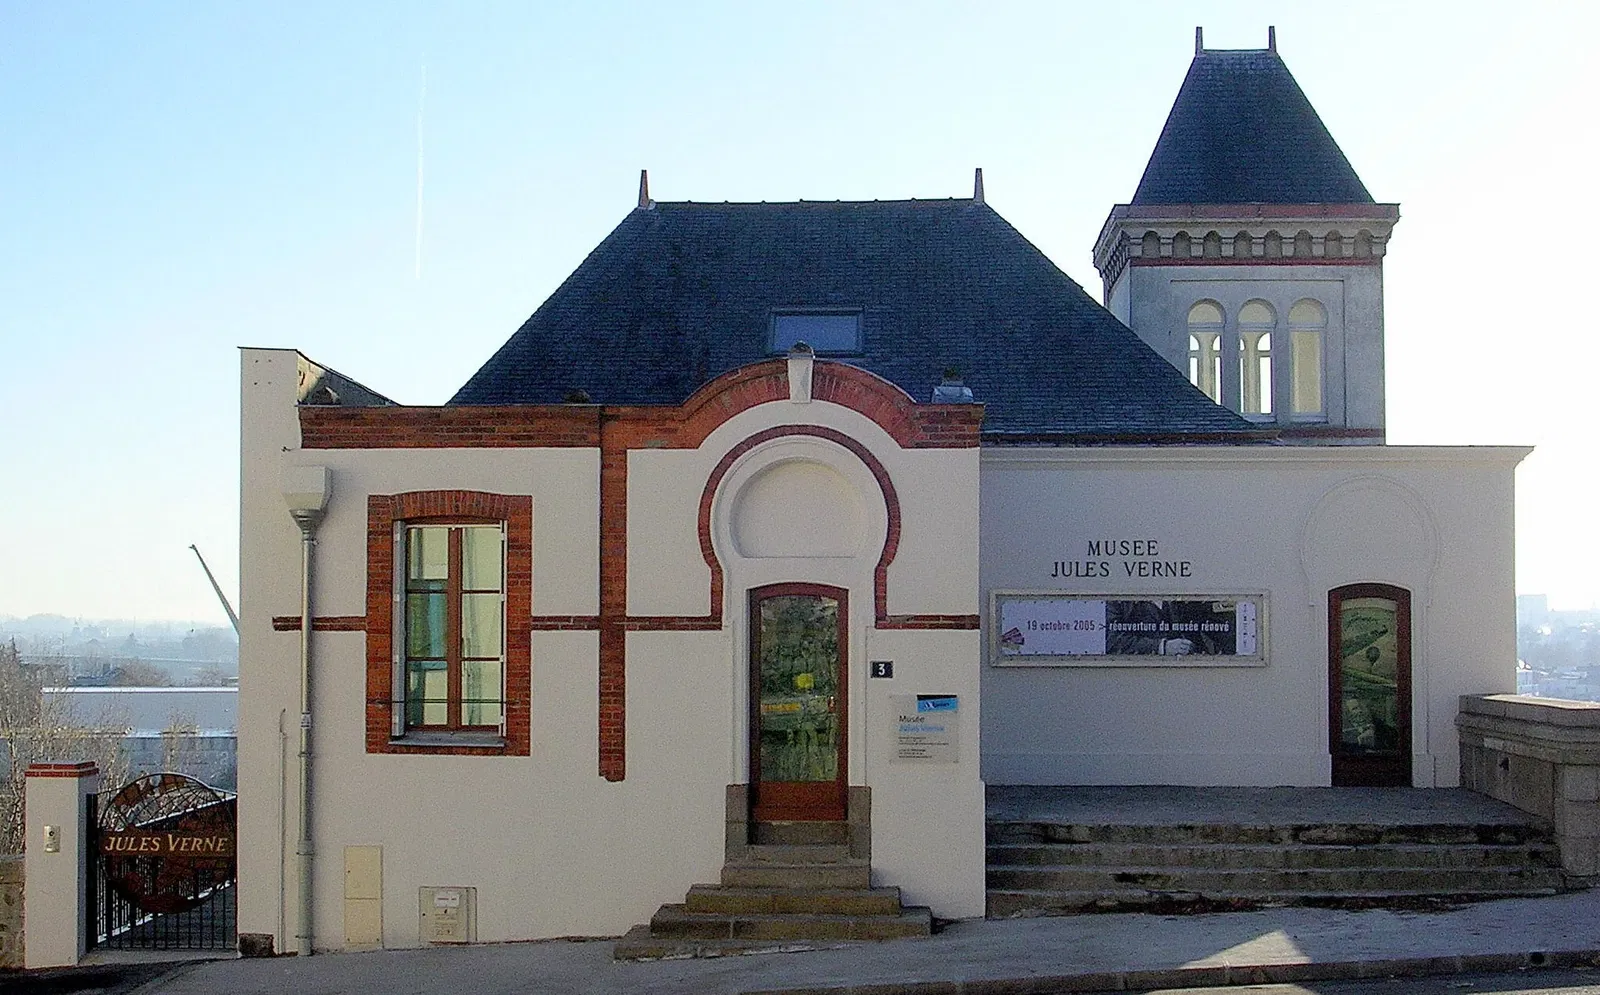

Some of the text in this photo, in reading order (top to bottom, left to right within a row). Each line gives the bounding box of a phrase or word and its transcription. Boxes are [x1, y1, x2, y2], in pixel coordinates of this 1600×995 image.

[1087, 540, 1159, 556] MUSEE
[1051, 561, 1192, 578] JULES VERNE
[1027, 620, 1230, 632] 19 octobre 2005 réouverture du musée rénové
[878, 663, 885, 676] 3
[105, 834, 228, 851] JULES VERNE
